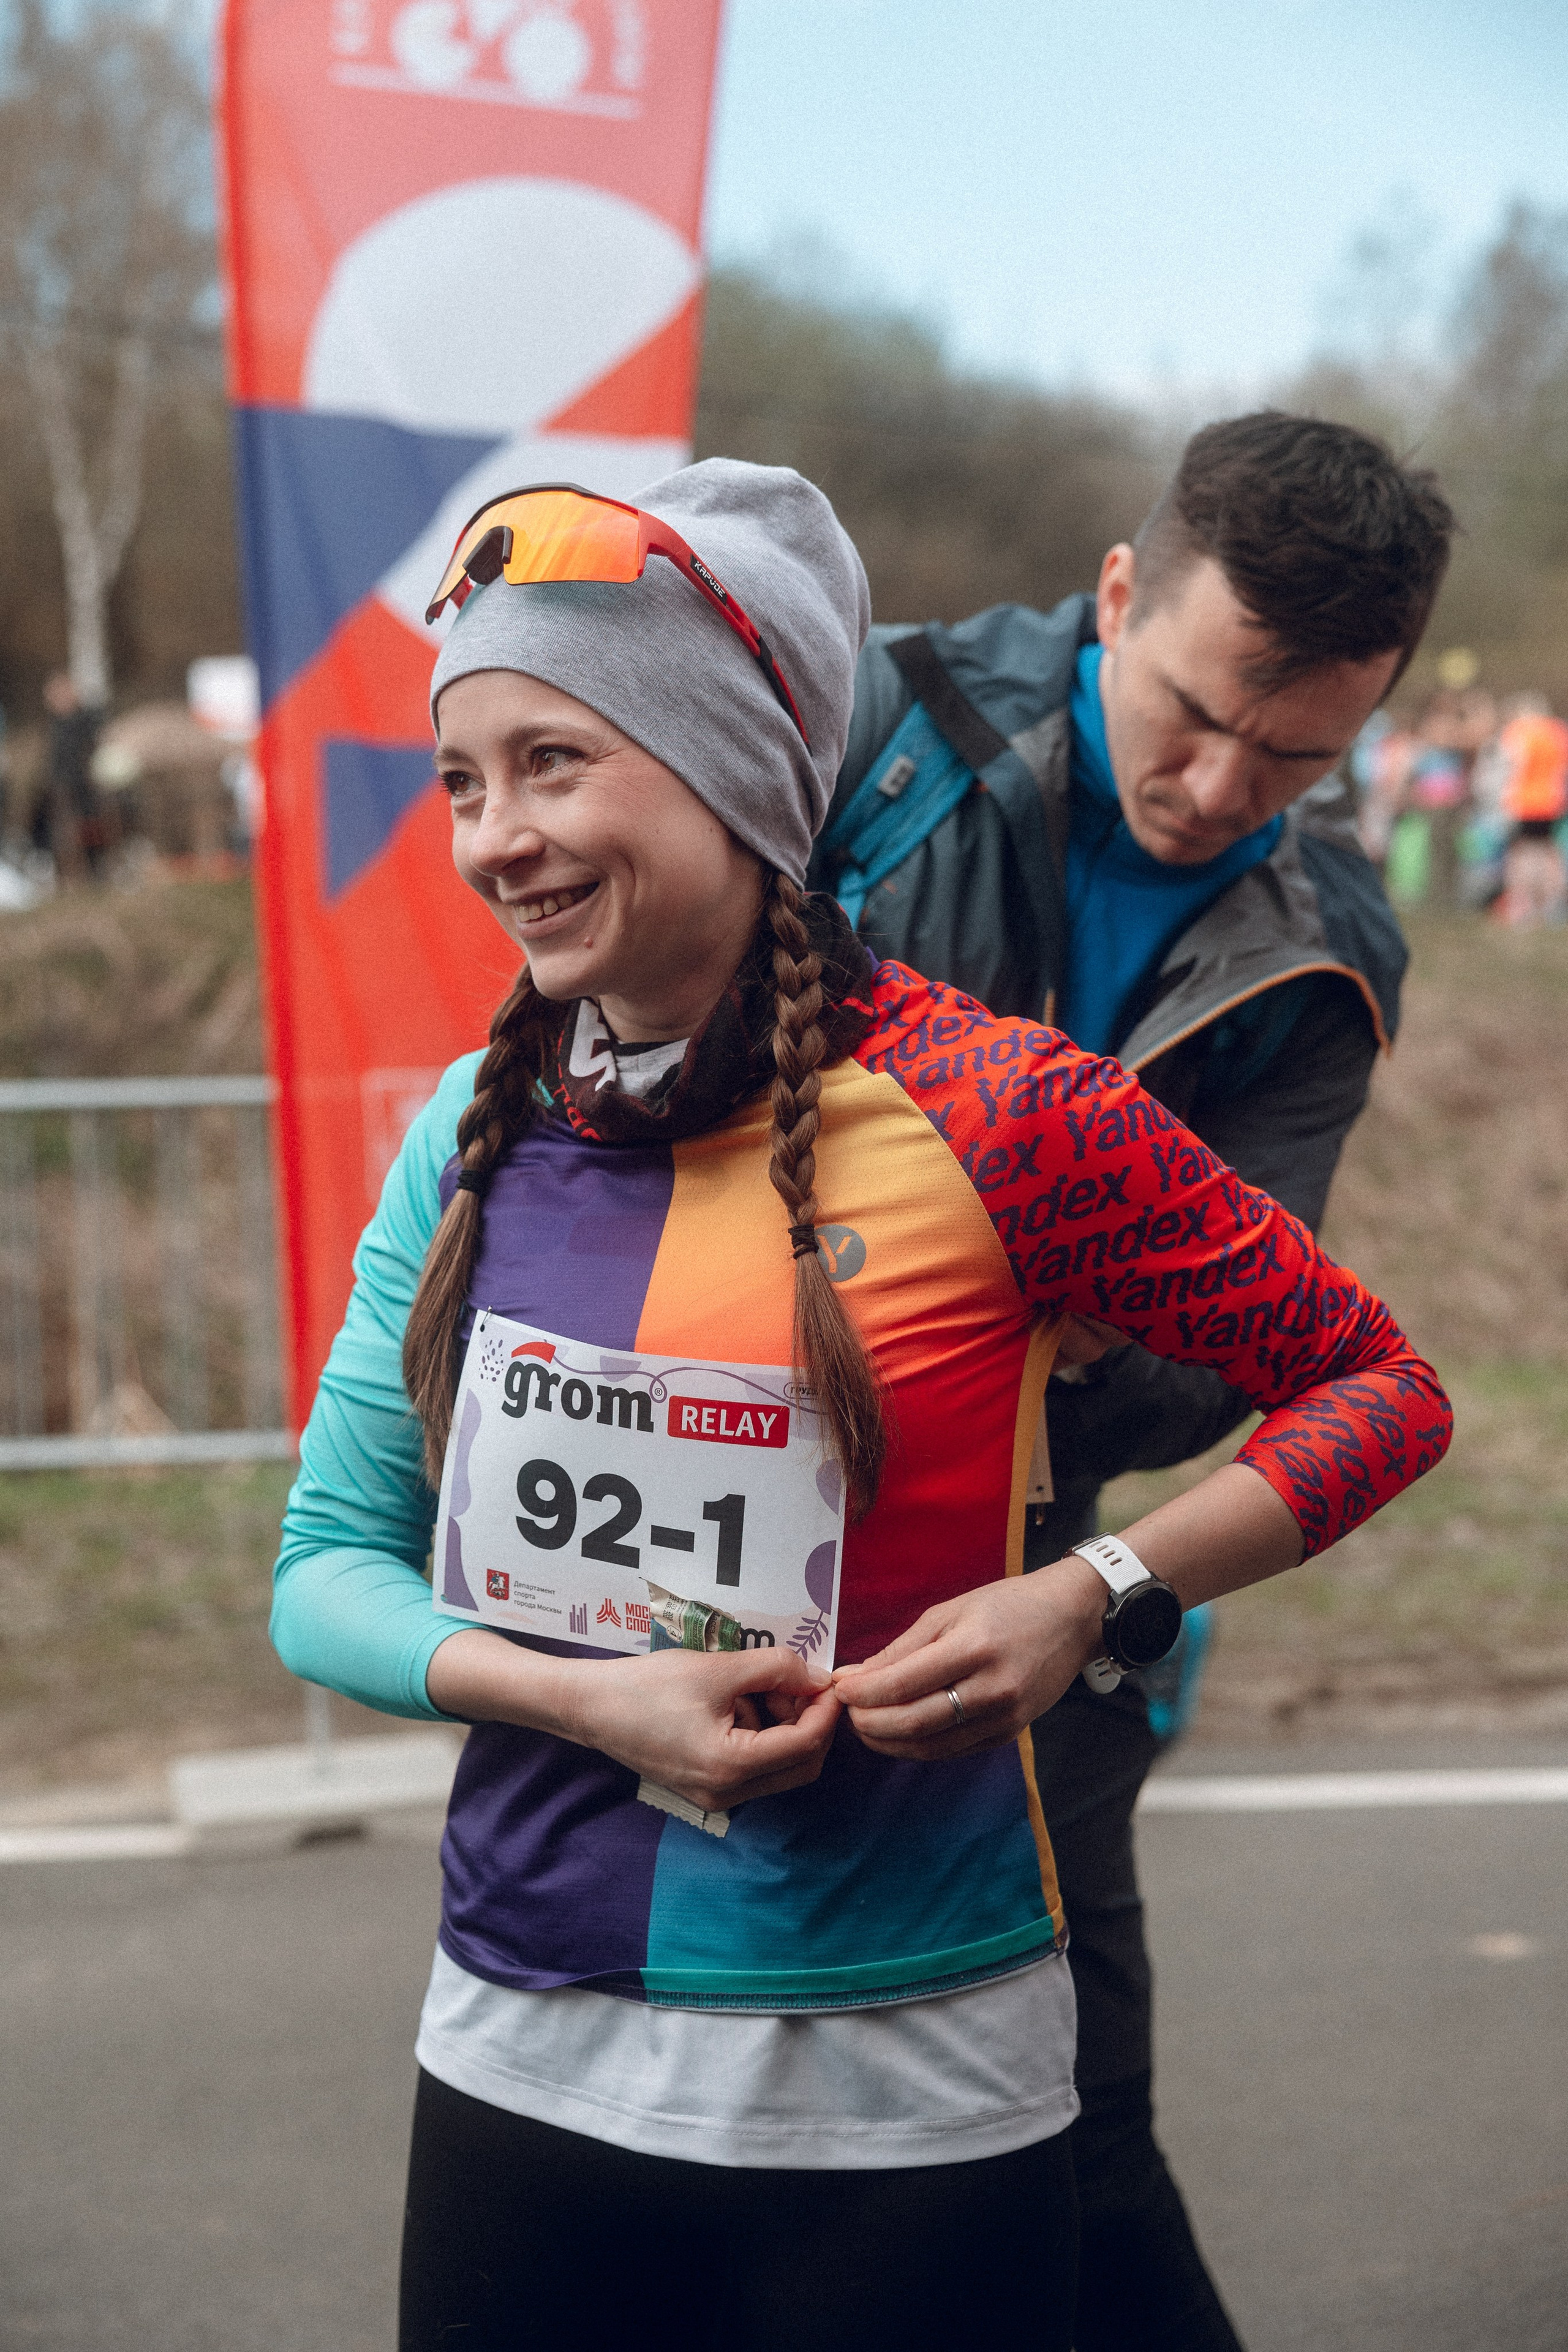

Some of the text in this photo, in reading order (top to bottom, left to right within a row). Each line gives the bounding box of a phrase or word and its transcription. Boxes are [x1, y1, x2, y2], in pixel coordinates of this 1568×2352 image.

[867, 1011, 995, 1072] ndex
[1064, 1101, 1187, 1162] Yand
[989, 1164, 1133, 1245] ndex
[1008, 1201, 1210, 1295] Yandex
[1091, 1234, 1286, 1313] Yandex
[501, 1361, 777, 1439] grom RELAY
[516, 1458, 747, 1588] 92-1
[513, 1580, 555, 1595] Департамент
[513, 1591, 536, 1600] спорта
[513, 1600, 562, 1615] города Москвы
